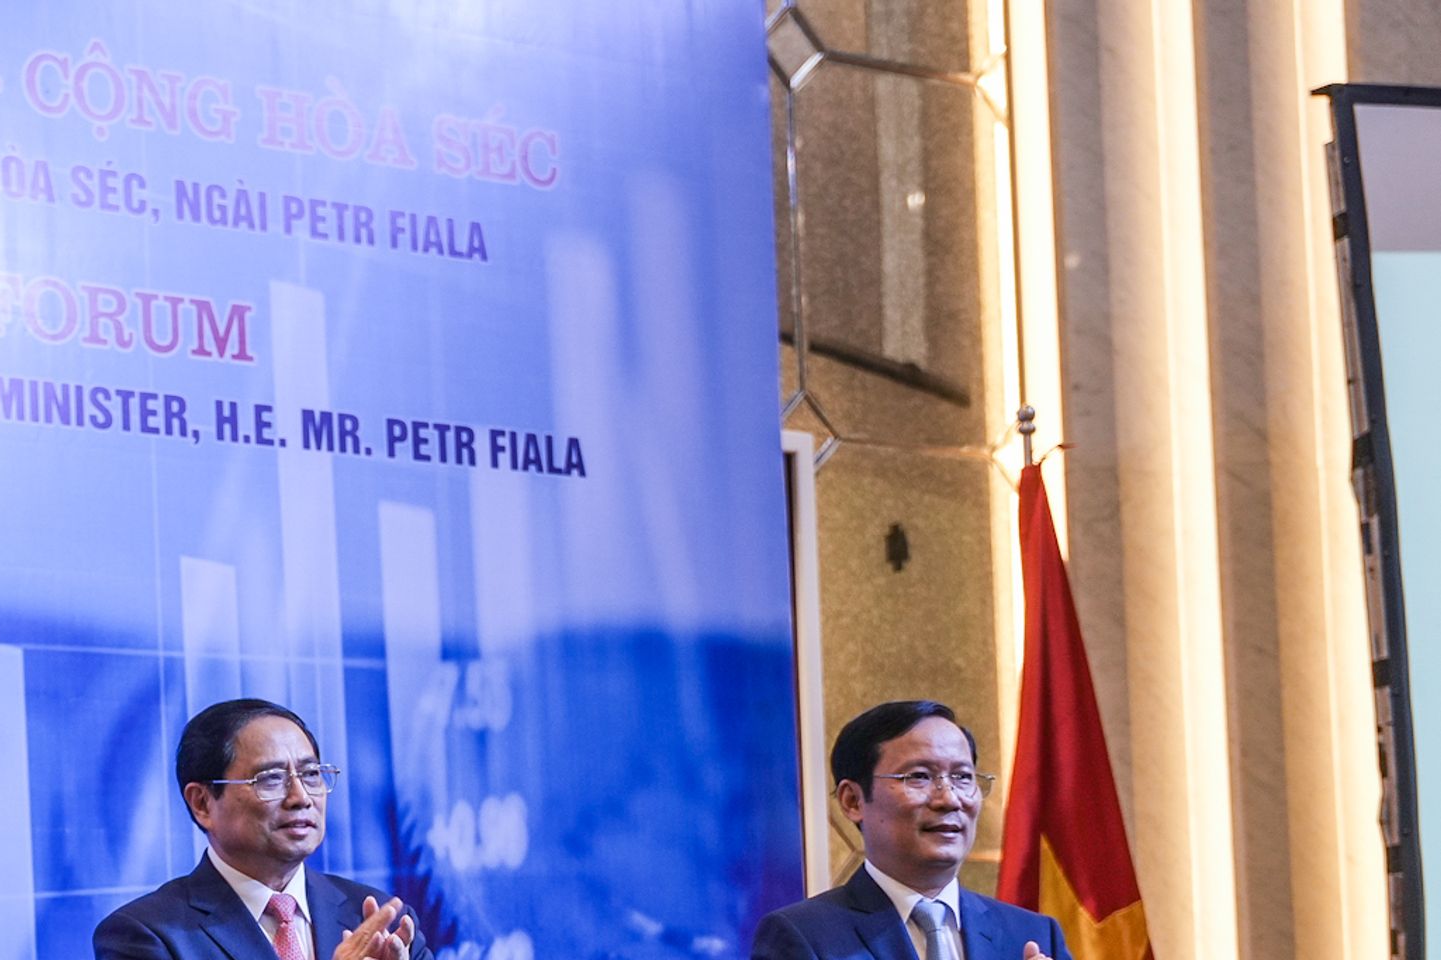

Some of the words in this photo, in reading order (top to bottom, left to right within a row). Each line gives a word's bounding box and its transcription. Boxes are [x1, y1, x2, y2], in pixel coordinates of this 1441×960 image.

[24, 40, 237, 142] CỘNG
[258, 78, 415, 168] HÒA
[433, 107, 559, 188] SÉC
[70, 161, 159, 224] SÉC,
[175, 170, 266, 232] NGÀI
[283, 195, 375, 246] PETR
[389, 210, 488, 263] FIALA
[215, 400, 287, 449] H.E.
[301, 409, 373, 457] MR.
[385, 418, 477, 468] PETR
[488, 431, 588, 479] FIALA
